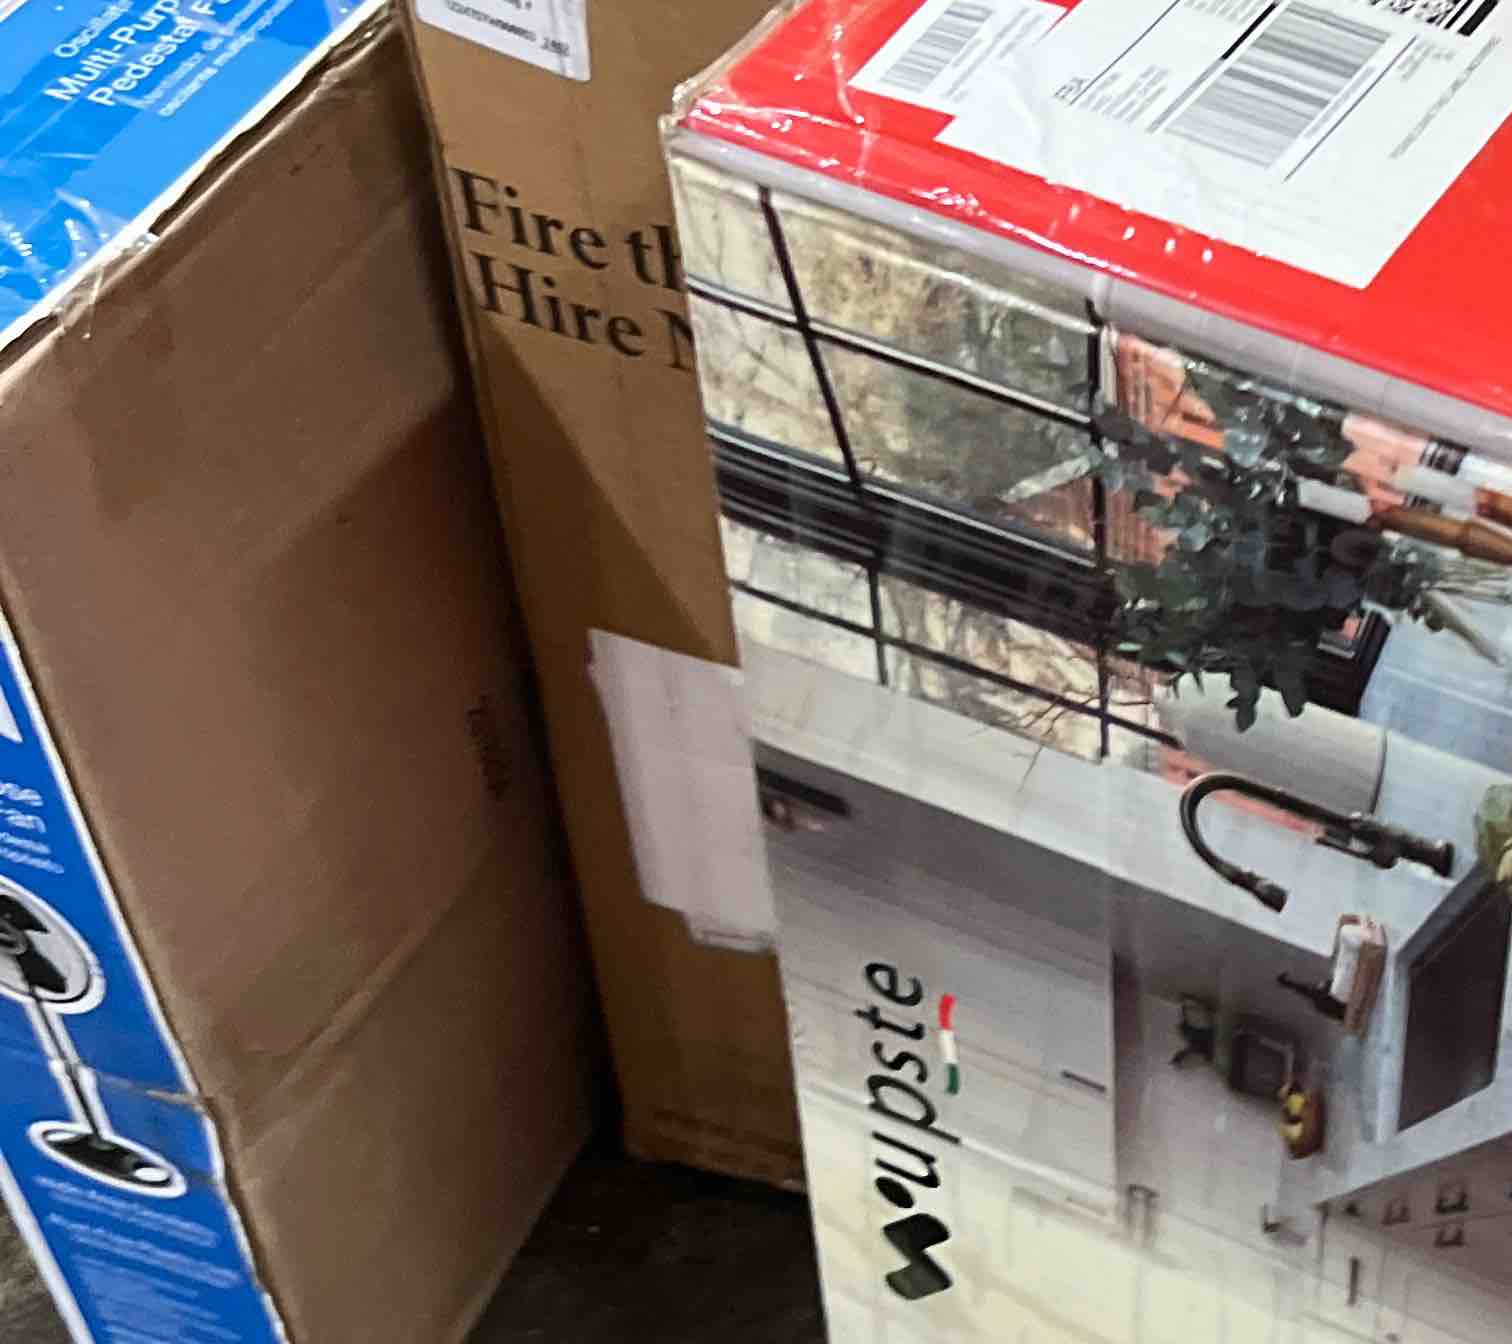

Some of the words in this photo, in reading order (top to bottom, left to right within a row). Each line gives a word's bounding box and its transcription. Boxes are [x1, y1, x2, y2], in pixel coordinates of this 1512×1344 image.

[86, 14, 201, 107] Pedestal
[448, 166, 610, 271] Fire
[467, 250, 647, 357] Hire
